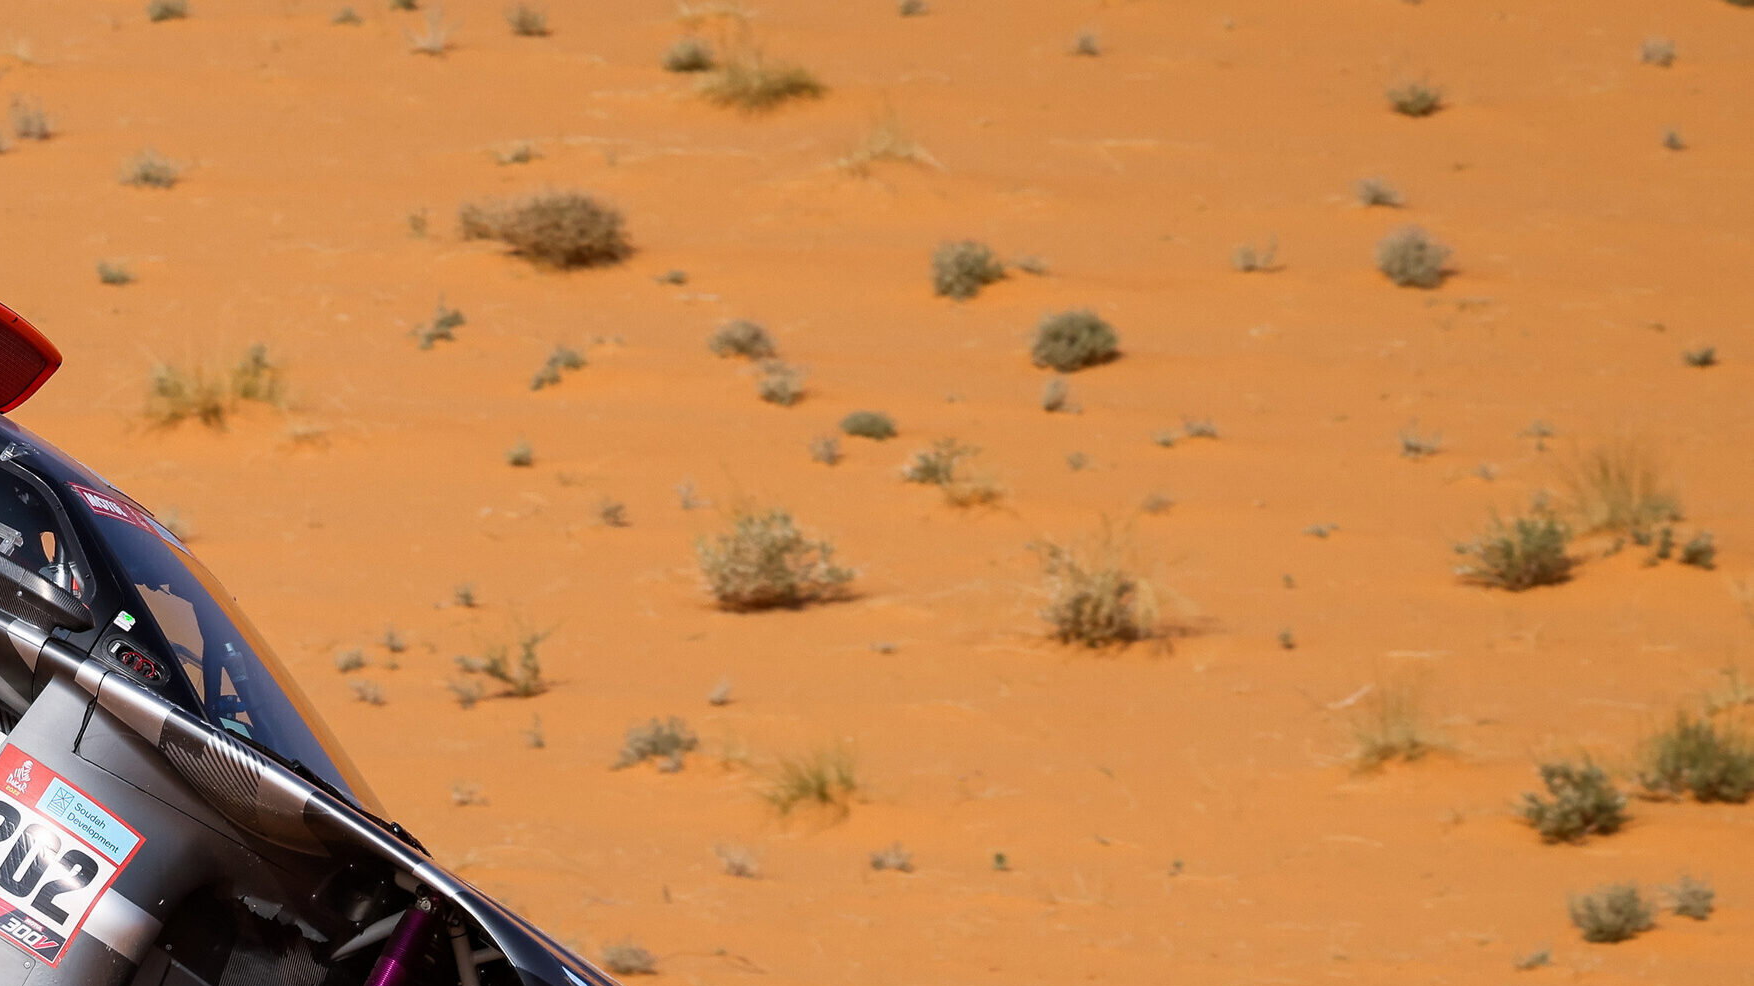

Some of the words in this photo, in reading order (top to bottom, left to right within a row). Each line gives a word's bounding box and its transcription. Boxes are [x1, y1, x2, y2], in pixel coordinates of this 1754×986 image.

[66, 811, 120, 854] Development
[73, 802, 107, 830] Soudah
[0, 916, 60, 950] 300V
